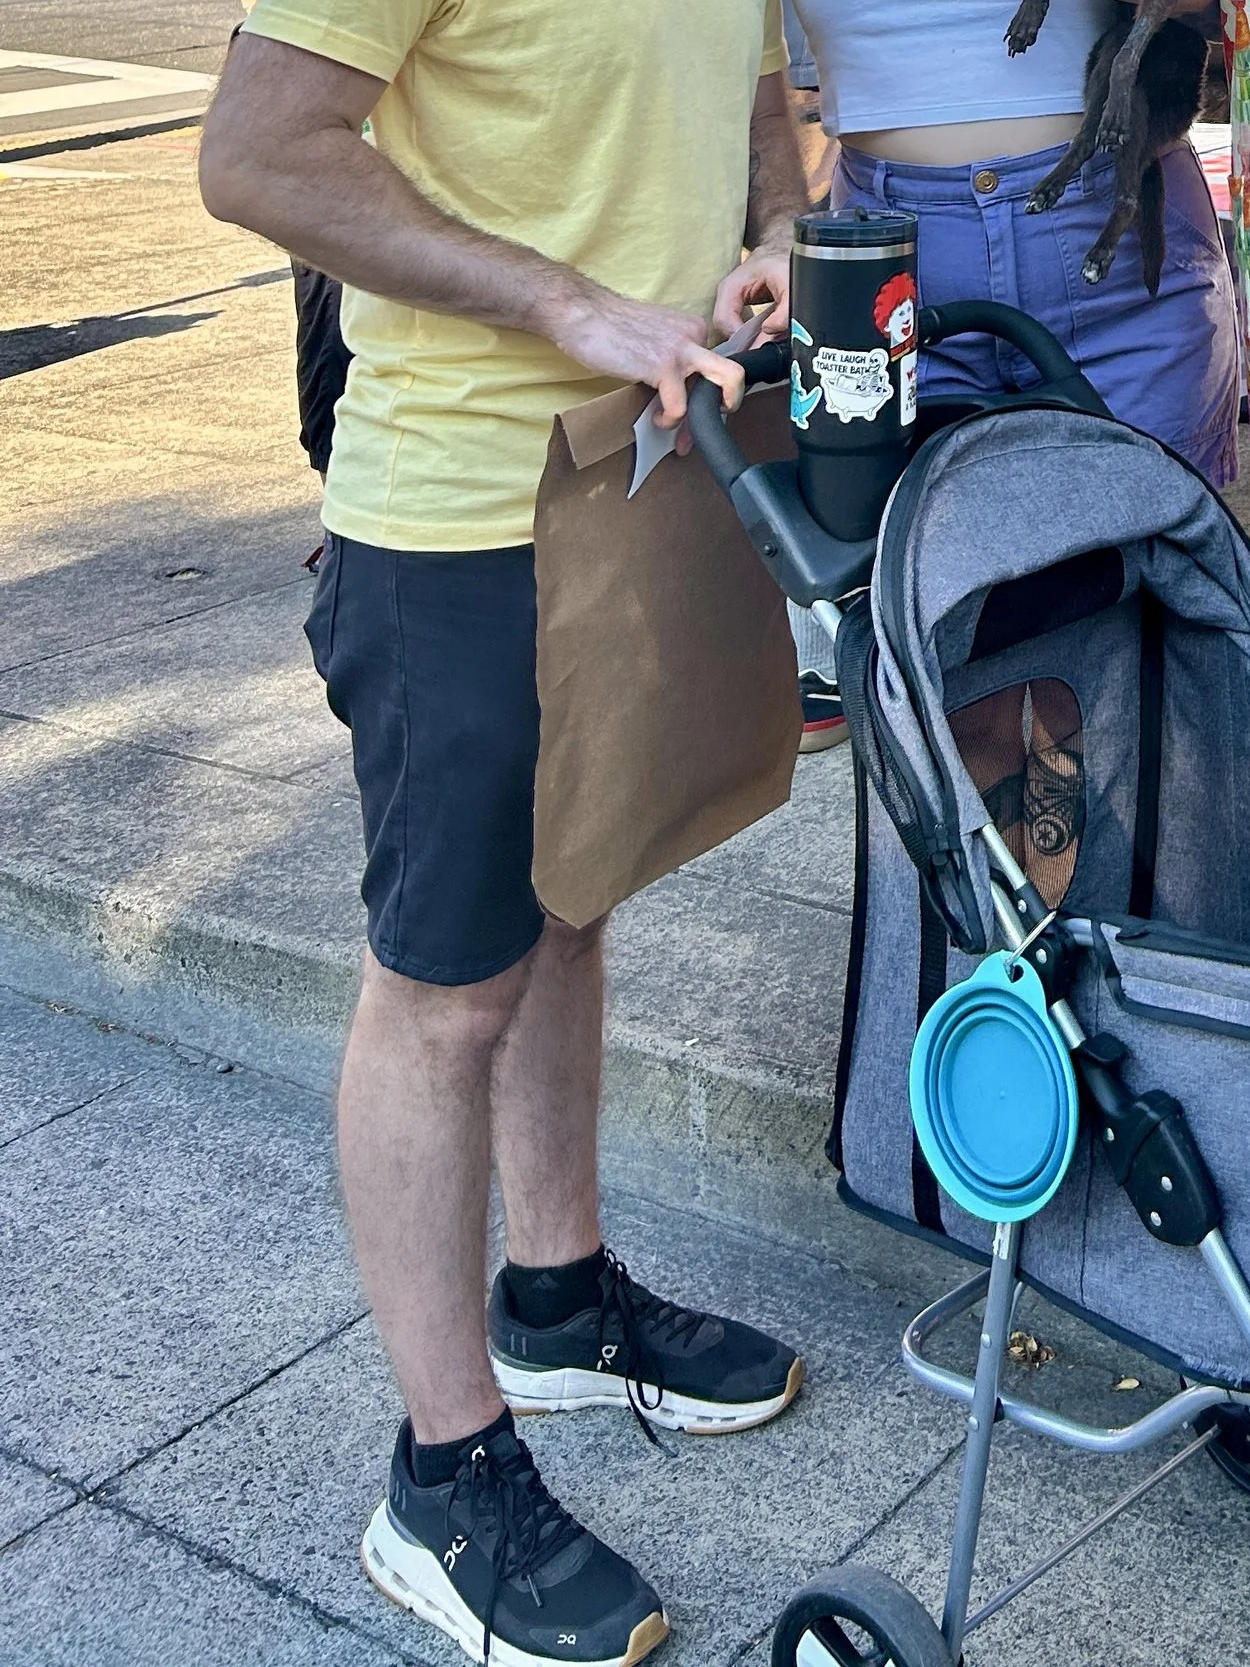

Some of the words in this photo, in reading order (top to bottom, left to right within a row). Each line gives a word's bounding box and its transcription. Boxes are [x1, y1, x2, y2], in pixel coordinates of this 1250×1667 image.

[821, 351, 837, 362] LIVE
[840, 354, 867, 364] LAUGH
[816, 361, 848, 373] TOASTER
